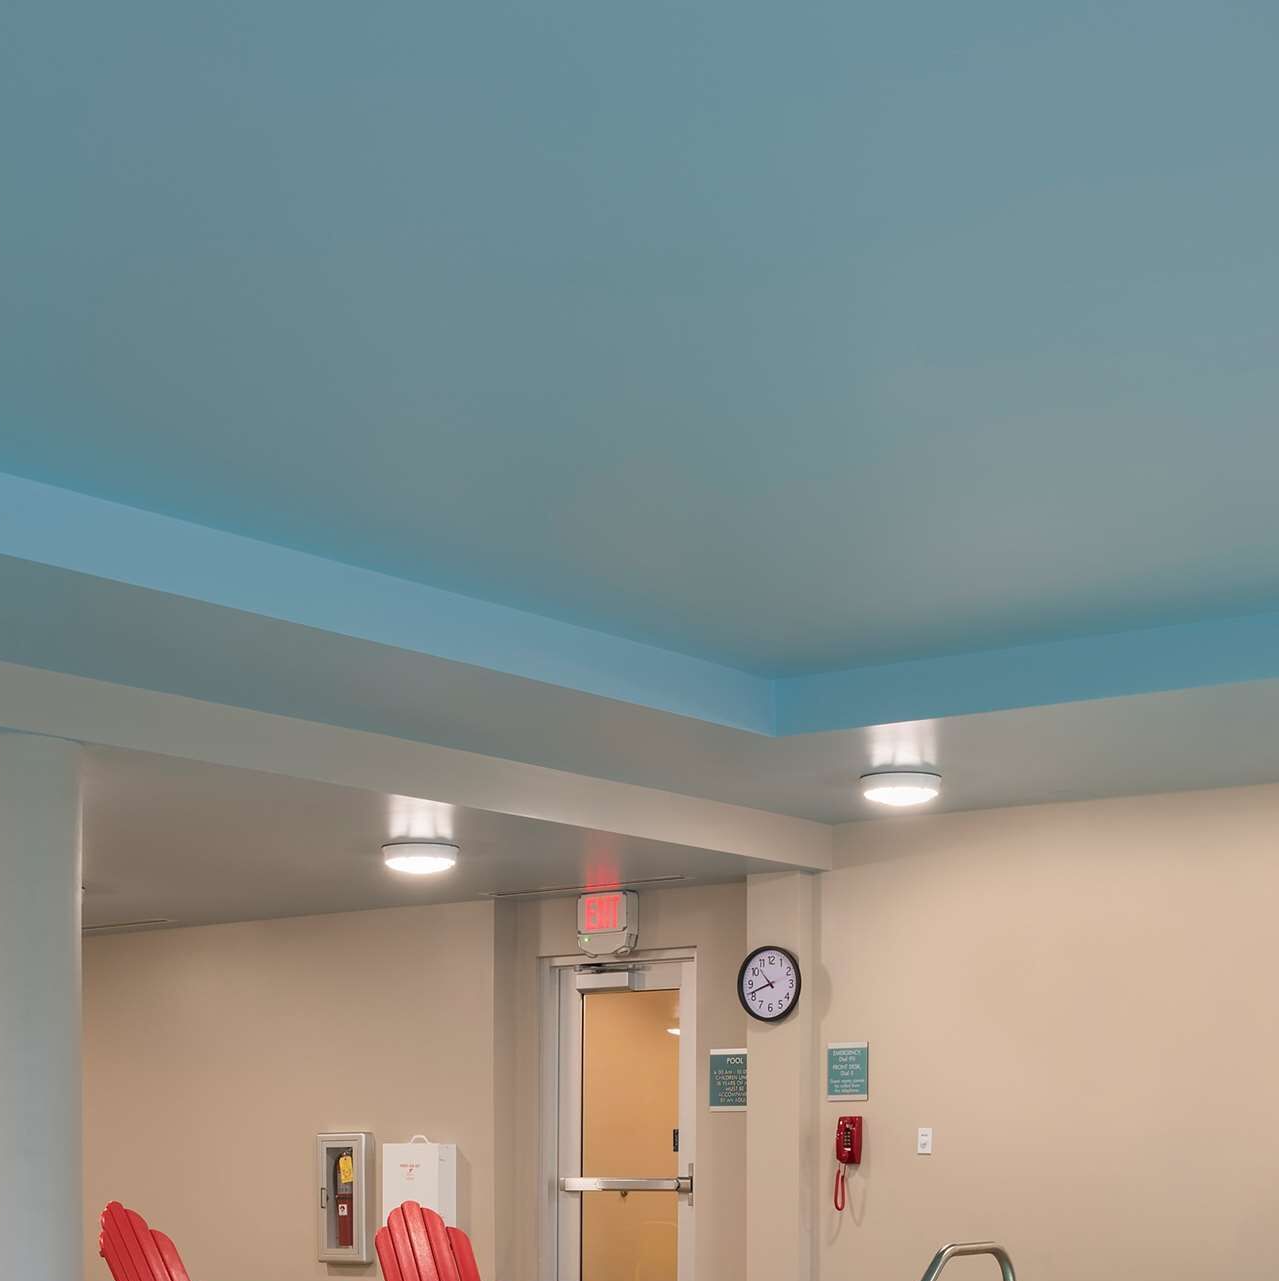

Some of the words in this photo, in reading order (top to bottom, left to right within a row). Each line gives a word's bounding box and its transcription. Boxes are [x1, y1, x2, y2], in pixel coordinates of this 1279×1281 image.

[585, 895, 621, 930] EXIT
[759, 959, 765, 968] 11
[768, 955, 776, 965] 12
[752, 967, 760, 976] 10
[786, 967, 791, 976] 2
[748, 980, 754, 989] 9
[789, 979, 794, 988] 3
[751, 992, 757, 1001] 8
[784, 992, 790, 1001] 4
[758, 1000, 764, 1009] 7
[768, 1003, 773, 1012] 6
[778, 1000, 783, 1009] 5
